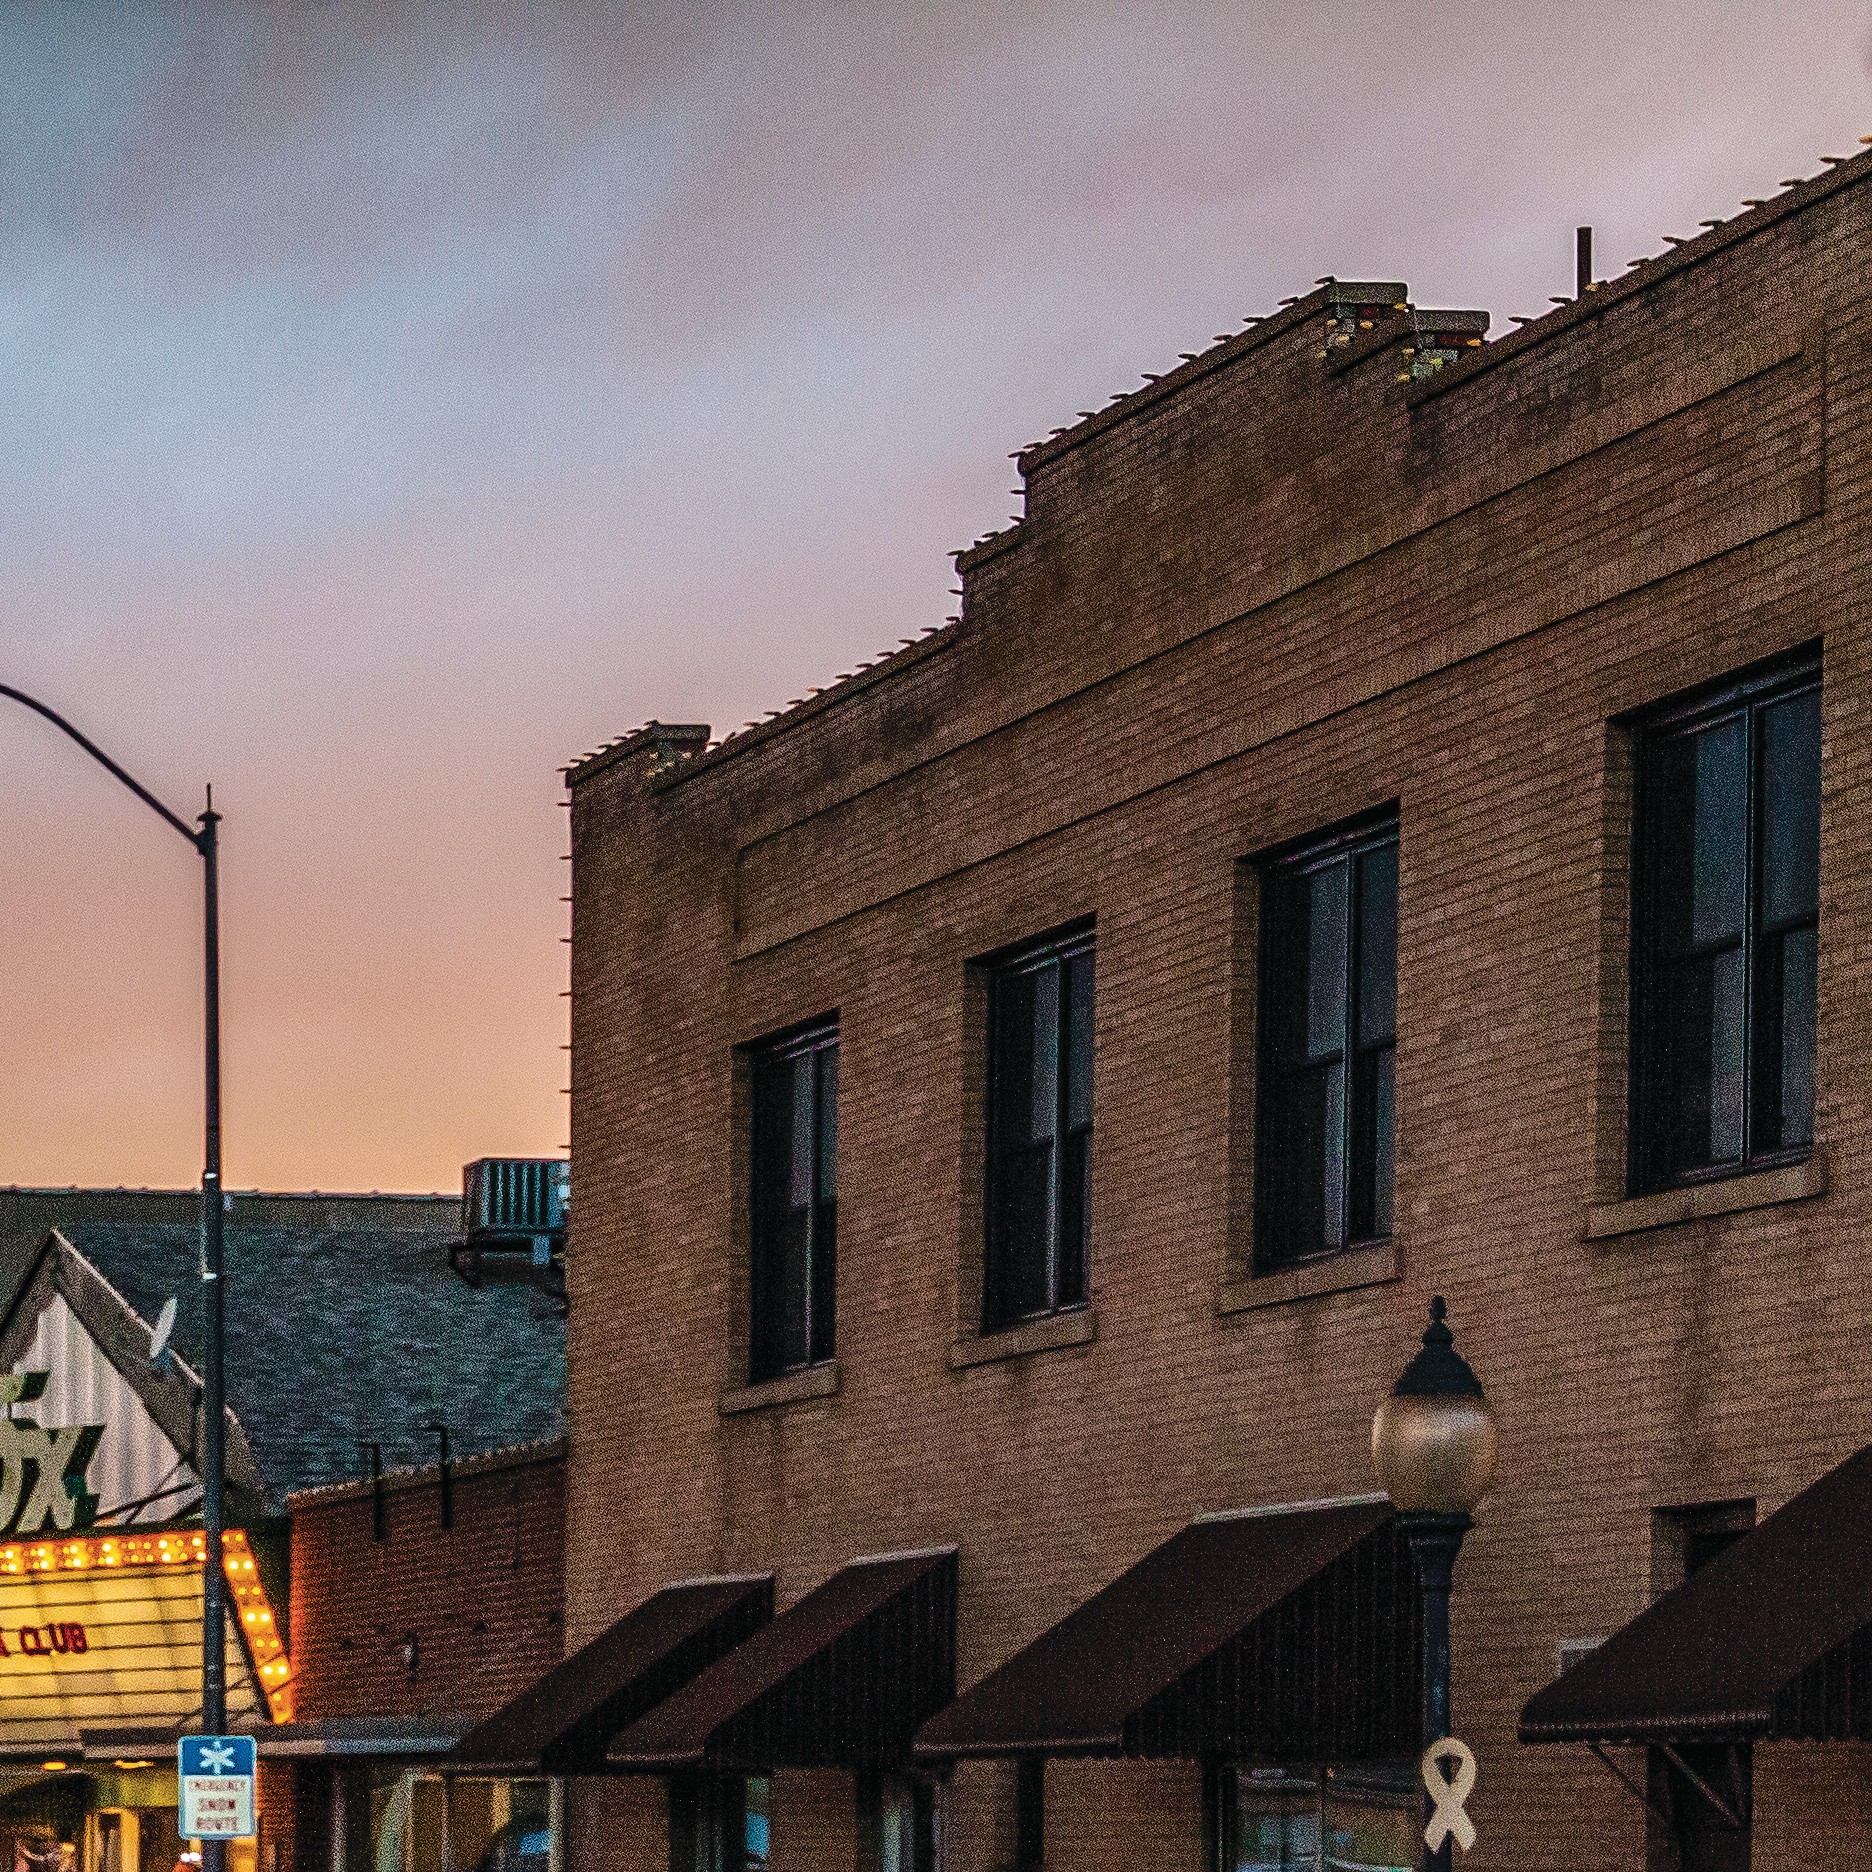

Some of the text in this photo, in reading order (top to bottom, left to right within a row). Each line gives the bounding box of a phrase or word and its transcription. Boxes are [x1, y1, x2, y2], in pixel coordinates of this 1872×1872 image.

[17, 1622, 88, 1656] CLUB
[197, 1797, 237, 1812] SNOW
[194, 1817, 239, 1832] ROUTE
